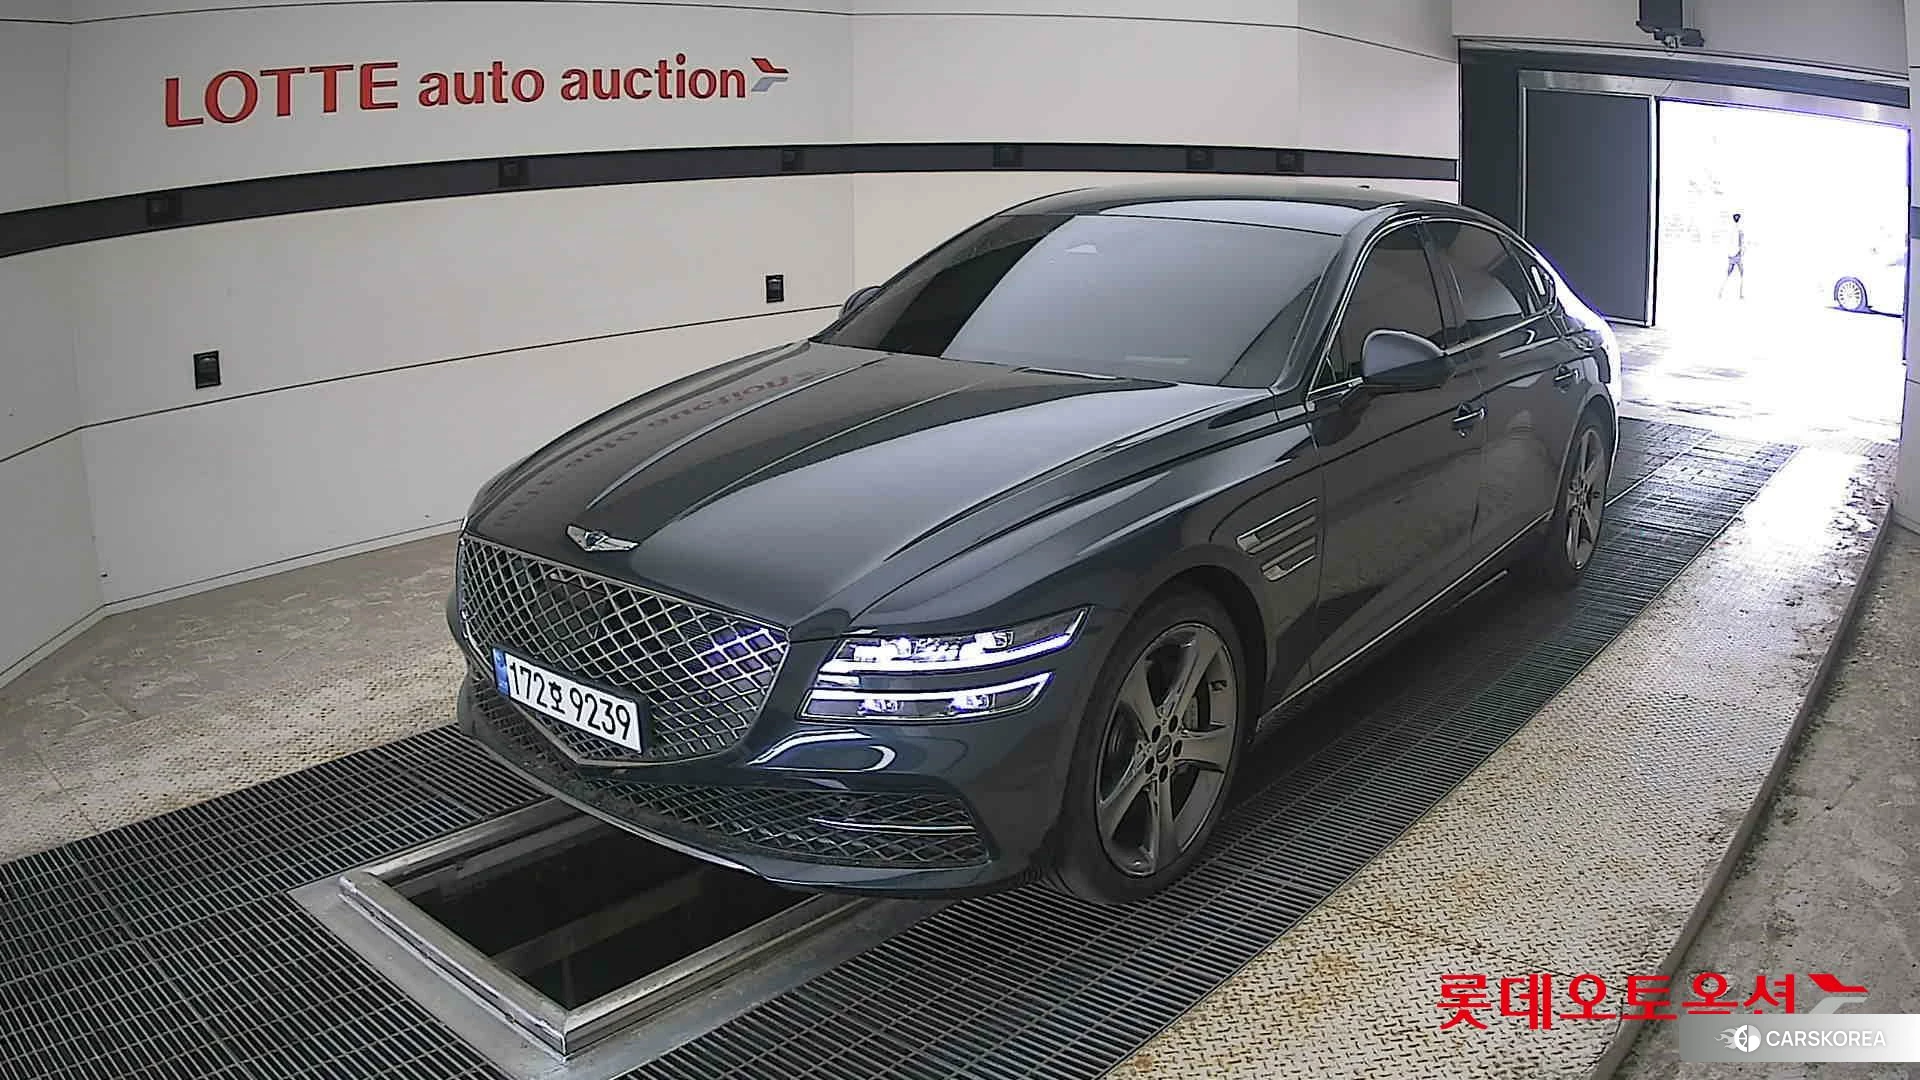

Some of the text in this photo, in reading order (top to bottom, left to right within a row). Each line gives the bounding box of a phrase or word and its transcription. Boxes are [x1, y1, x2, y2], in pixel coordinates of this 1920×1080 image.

[165, 52, 748, 128] LOTTE auto auction
[509, 662, 631, 740] 172호 9239
